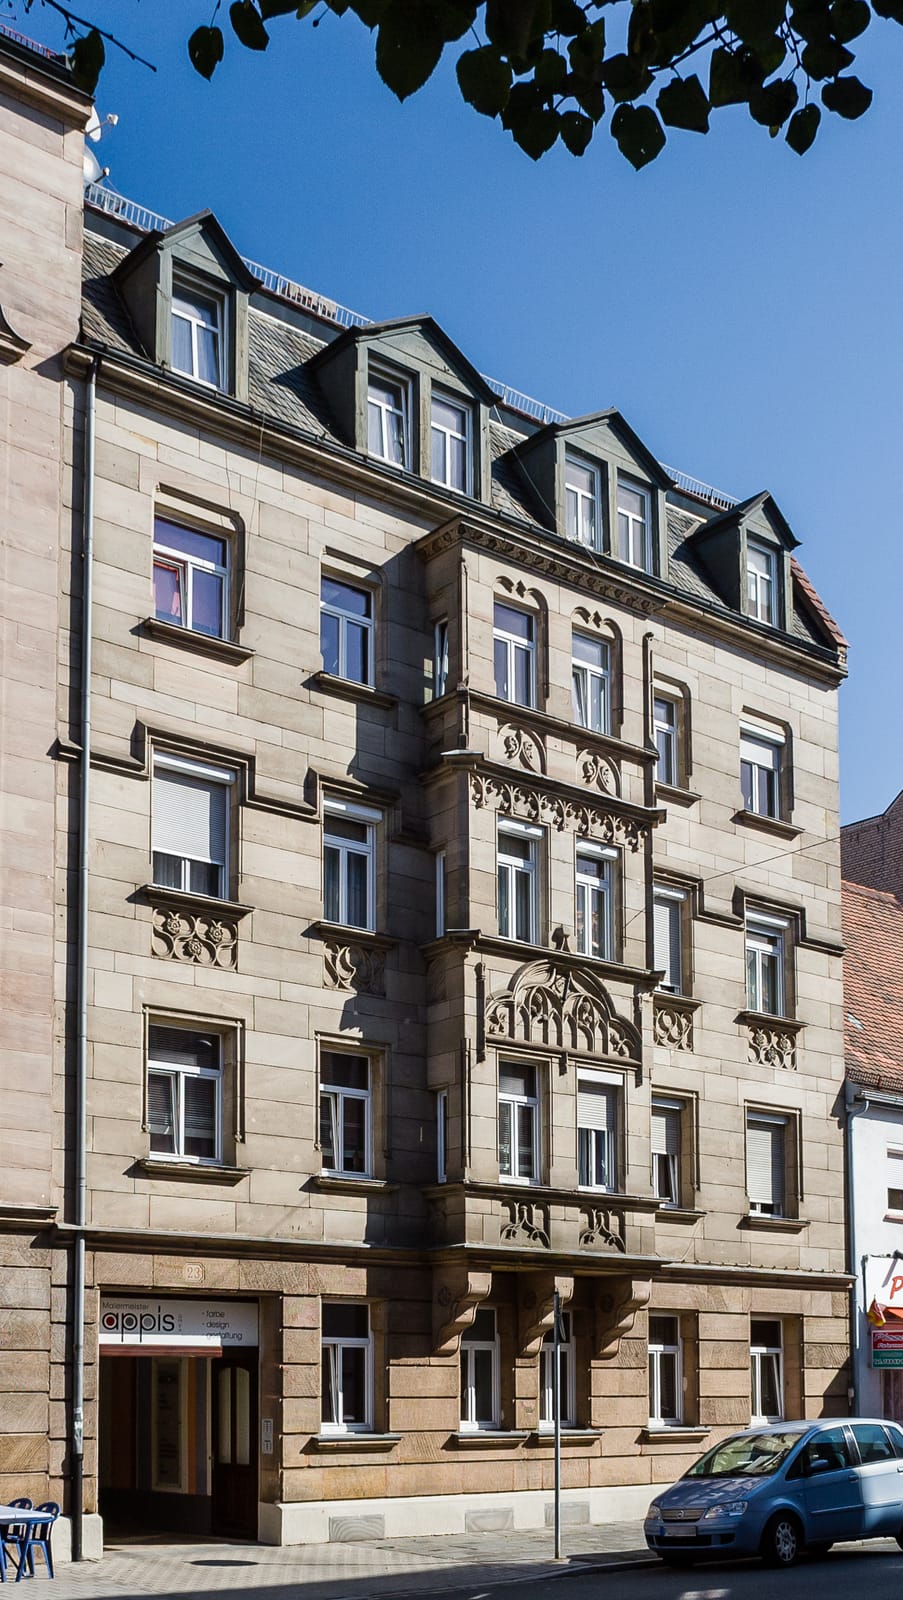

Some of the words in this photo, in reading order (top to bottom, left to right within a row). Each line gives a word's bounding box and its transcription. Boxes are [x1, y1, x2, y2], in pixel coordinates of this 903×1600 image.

[187, 1268, 201, 1279] 23
[206, 1310, 225, 1318] farbe
[102, 1305, 175, 1342] appis
[206, 1320, 230, 1330] design
